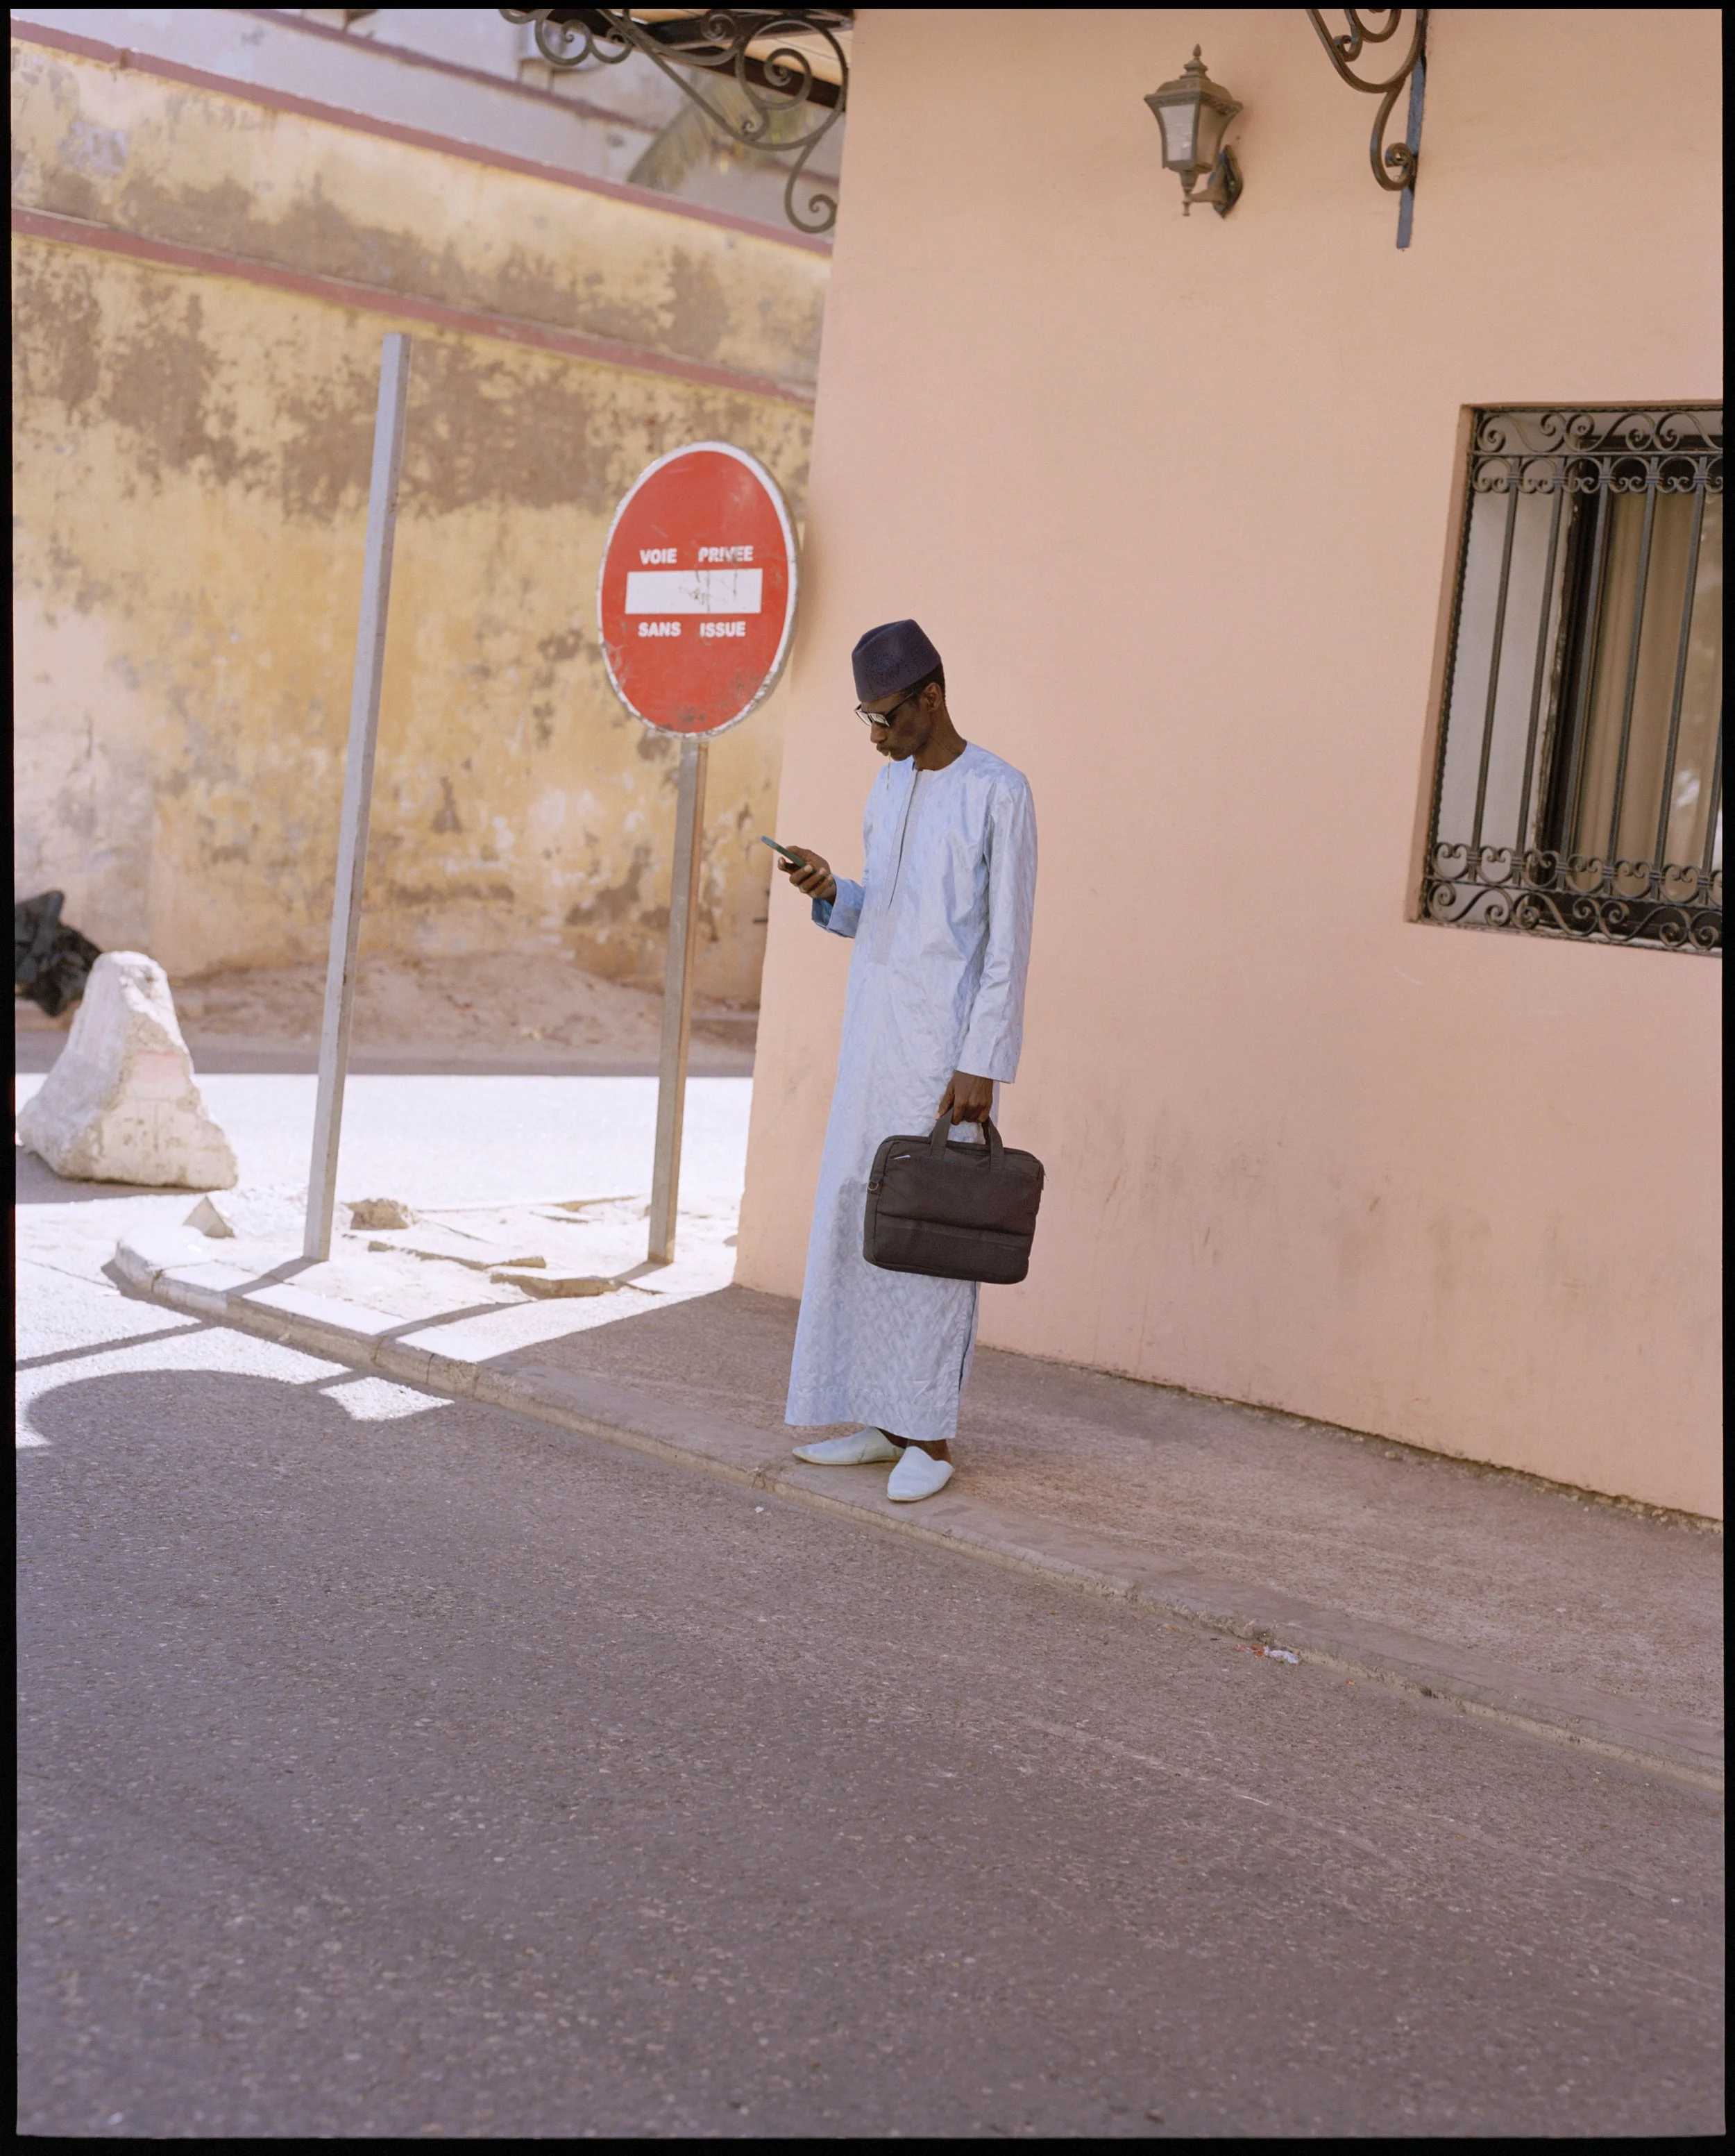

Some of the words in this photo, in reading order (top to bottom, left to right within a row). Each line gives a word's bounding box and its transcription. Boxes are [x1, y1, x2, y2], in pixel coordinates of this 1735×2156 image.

[640, 548, 677, 565] VOIE
[697, 545, 754, 563] PRIVEE
[638, 621, 682, 637] SANS
[700, 621, 746, 638] ISSUE
